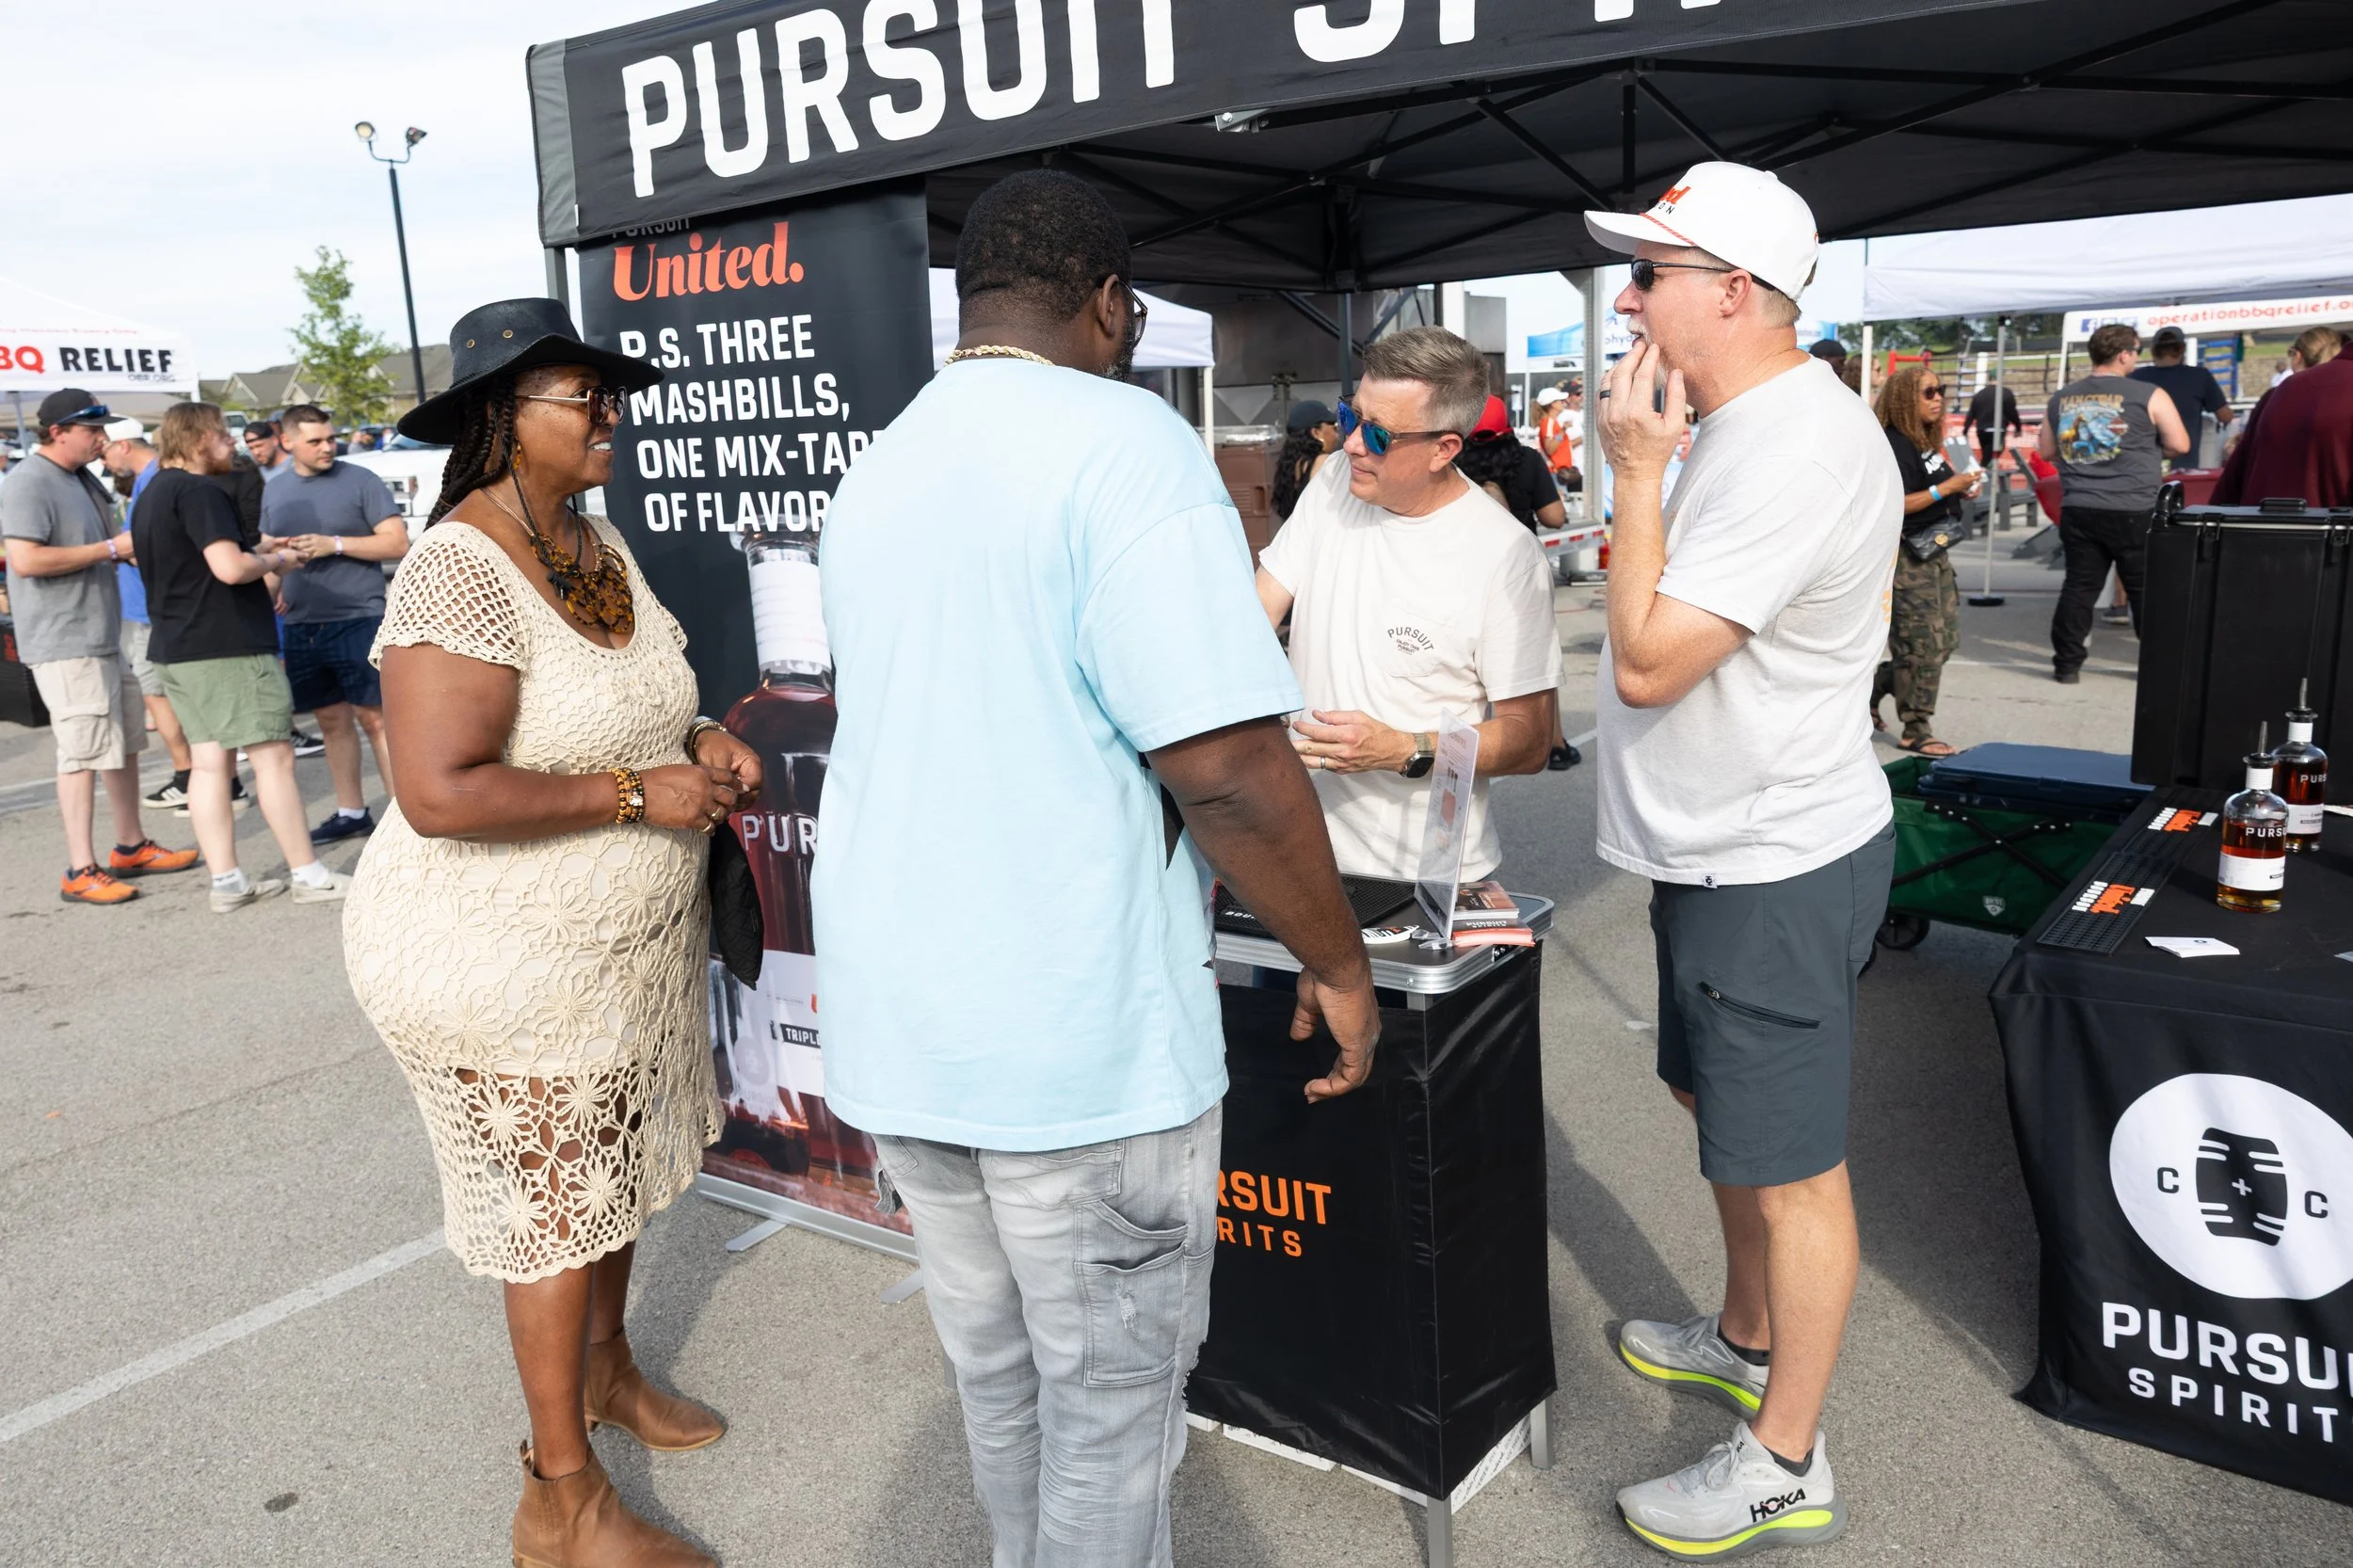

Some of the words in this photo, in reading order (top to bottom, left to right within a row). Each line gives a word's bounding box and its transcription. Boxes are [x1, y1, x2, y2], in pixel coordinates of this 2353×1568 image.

[1657, 202, 1675, 215] ON
[614, 221, 805, 301] United.
[2147, 299, 2353, 327] operationbbqrelief.o
[58, 346, 172, 373] RELIEF
[619, 327, 691, 369] P.S.
[696, 313, 815, 365] THREE
[629, 373, 850, 426] MASHBILLS,
[636, 437, 705, 479] ONE
[714, 429, 886, 478] MIX-TAP
[644, 492, 688, 532] OF
[696, 489, 832, 533] FLAVOR
[1387, 626, 1434, 650] PURSUIT
[742, 814, 818, 856] PUR
[2156, 1166, 2180, 1193] C
[2304, 1190, 2329, 1219] C
[1216, 1216, 1303, 1257] RITS
[2128, 1368, 2353, 1443] SPIRIT
[1749, 1487, 1806, 1523] HOKA
